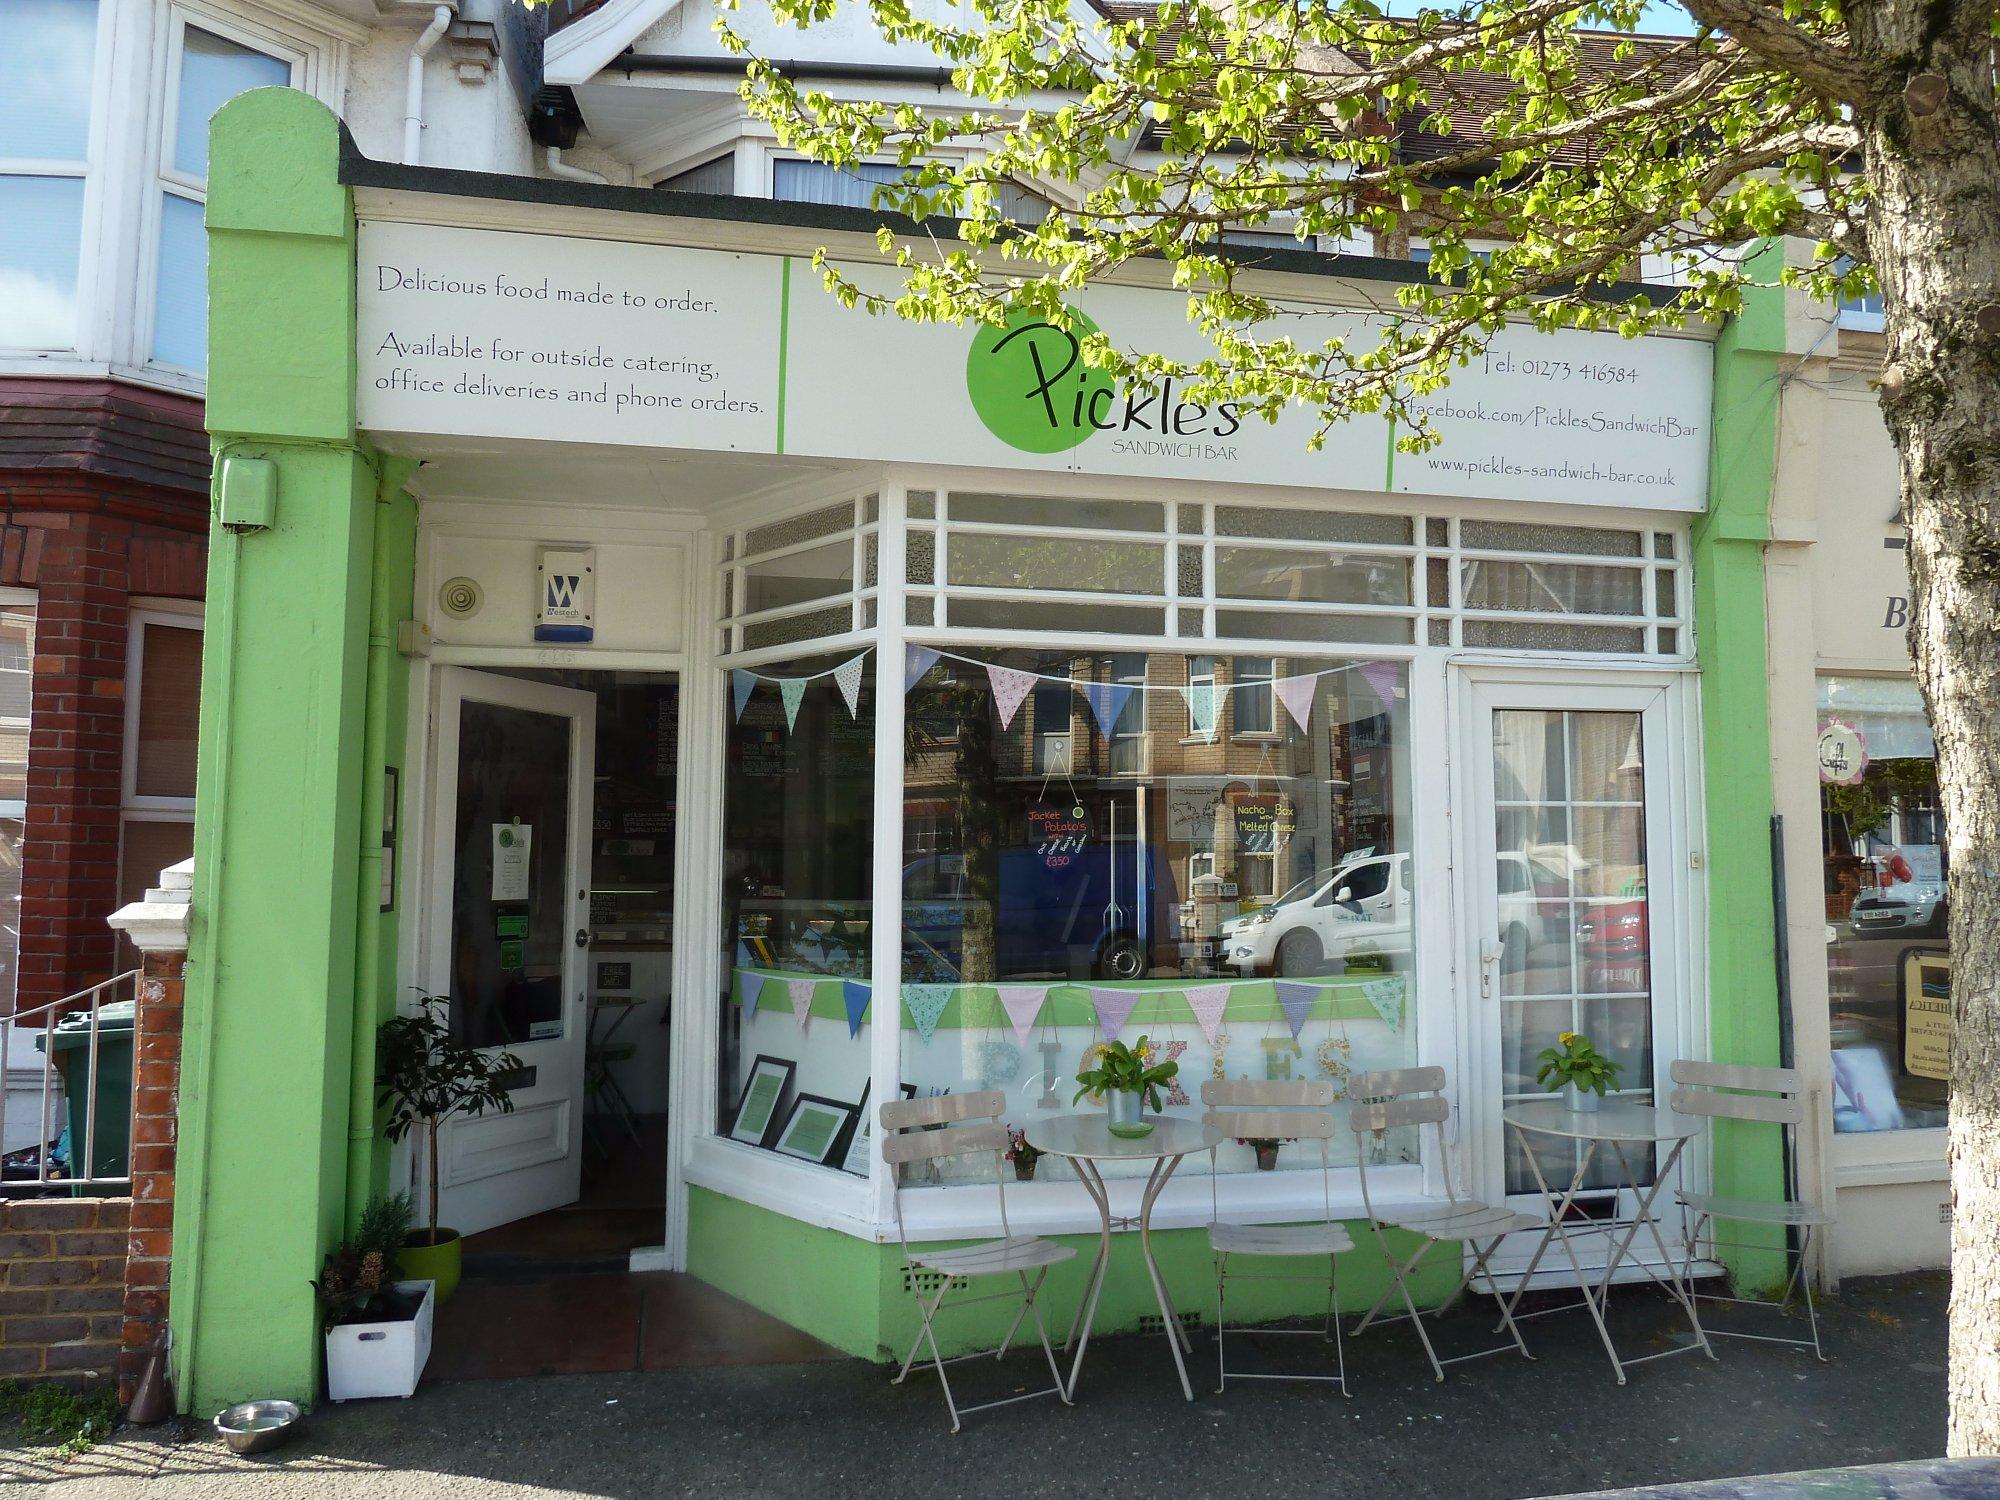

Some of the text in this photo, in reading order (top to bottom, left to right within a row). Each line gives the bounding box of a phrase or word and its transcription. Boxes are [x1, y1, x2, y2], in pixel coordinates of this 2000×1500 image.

[378, 266, 717, 312] Delicious food made to order.
[376, 332, 719, 382] Available for outside catering,
[1481, 350, 1639, 385] Tel: 01273 416584
[376, 368, 763, 414] office deliveries and phone orders.
[991, 322, 1241, 436] Pickles
[1408, 397, 1699, 438] facebook.com/PicklesSandwichBar
[1111, 439, 1239, 461] SANDWICH BAR
[1428, 456, 1676, 486] www.pickles-sandwich-bar.co.uk
[1027, 811, 1060, 820] Jacket
[1237, 804, 1294, 816] Nacho Box
[1239, 822, 1296, 832] Melted Cheese
